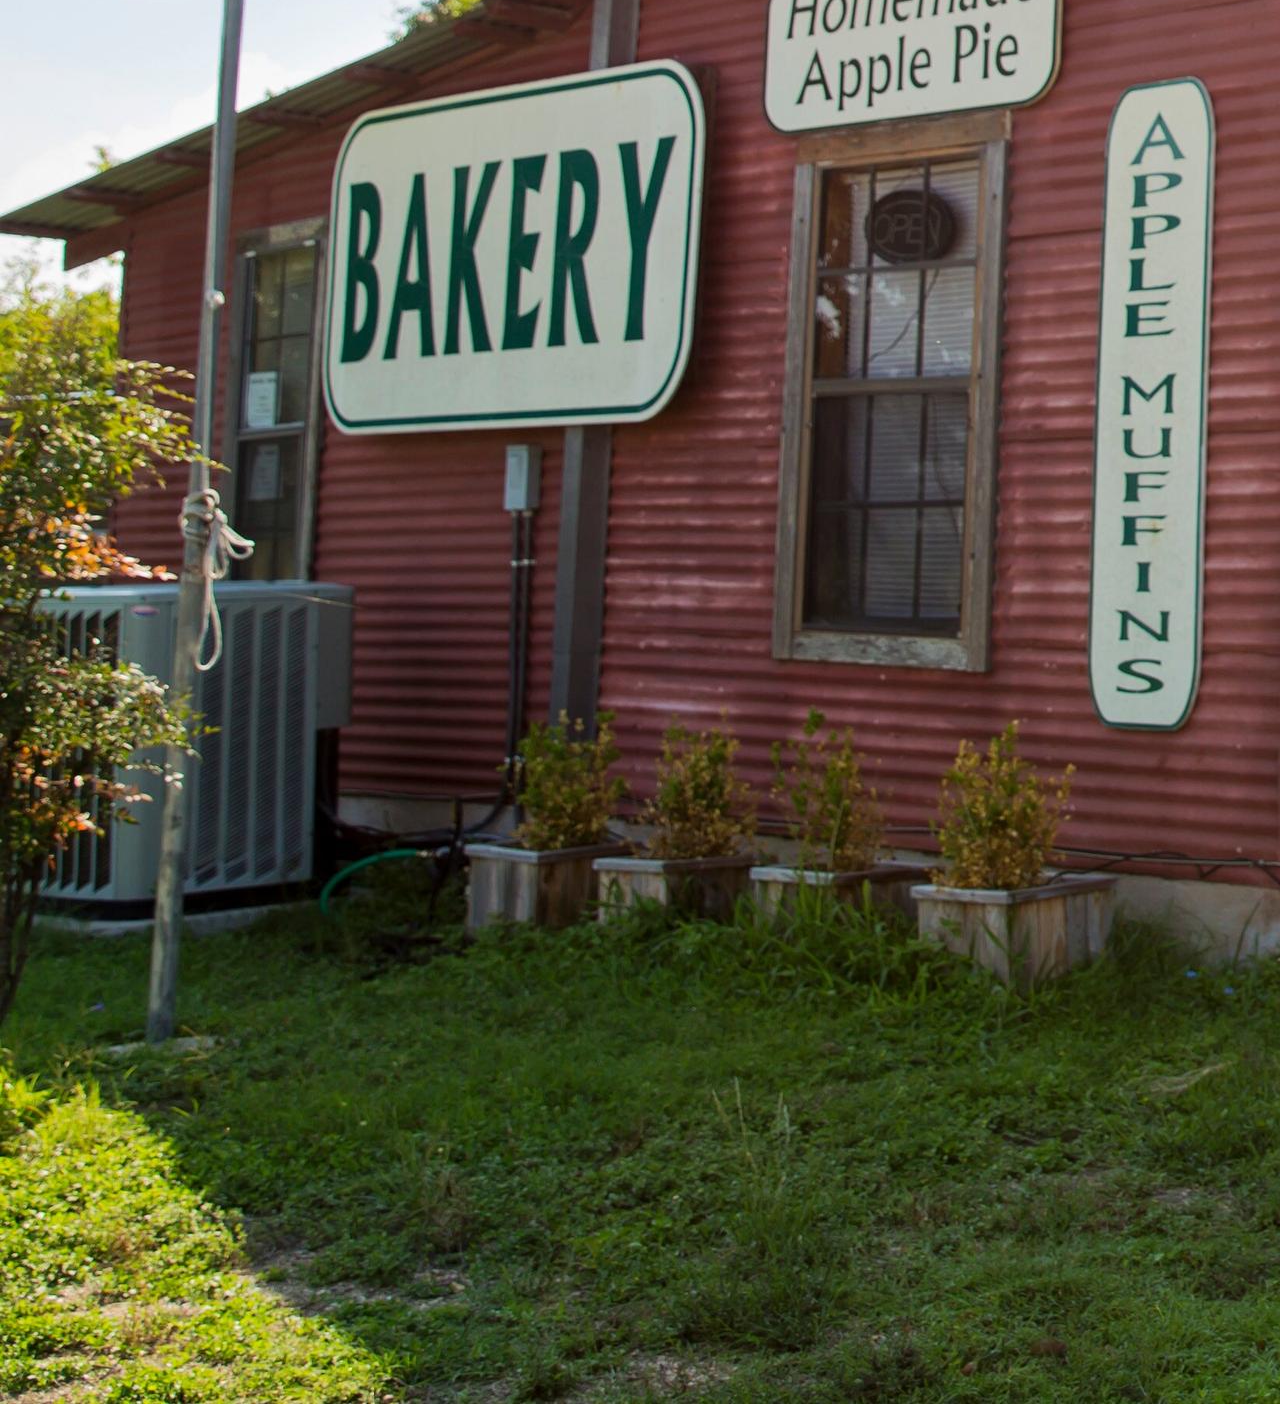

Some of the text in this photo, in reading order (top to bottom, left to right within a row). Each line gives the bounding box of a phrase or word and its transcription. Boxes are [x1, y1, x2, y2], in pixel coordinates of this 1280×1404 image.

[796, 23, 1019, 112] Apple Pie
[339, 136, 677, 363] BAKERY
[874, 210, 943, 248] OPEN
[1116, 112, 1186, 695] APPLE MUFFINS
